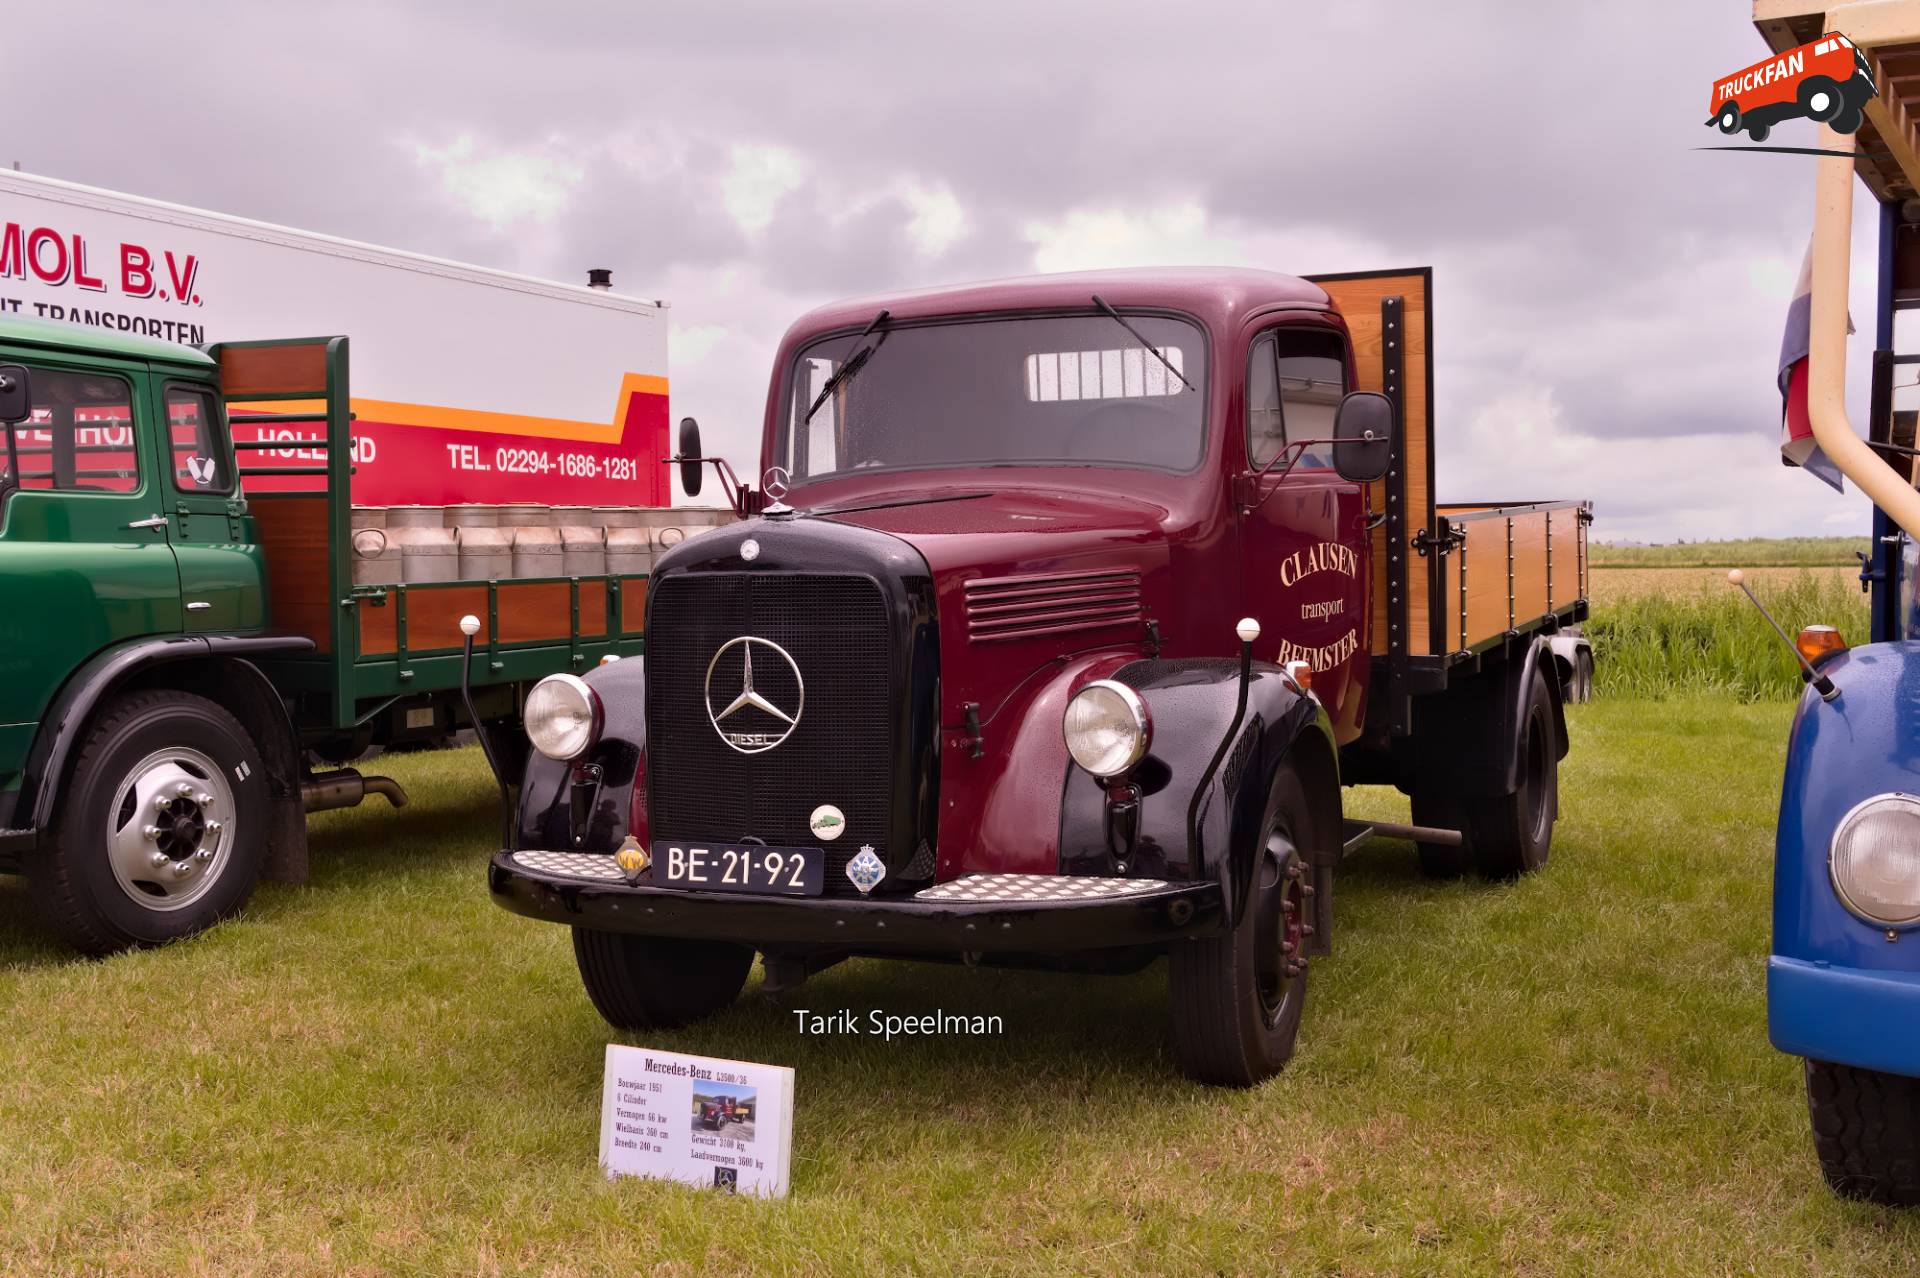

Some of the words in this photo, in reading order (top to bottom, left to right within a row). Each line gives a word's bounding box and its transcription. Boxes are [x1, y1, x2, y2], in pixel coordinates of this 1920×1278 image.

[120, 243, 203, 306] B.V.
[447, 444, 491, 471] TEL.
[496, 448, 637, 480] 02294-1686-1281
[1280, 542, 1359, 587] CLAUSEN
[1301, 598, 1344, 622] transport
[731, 733, 773, 746] DIESEL
[667, 847, 806, 887] BE-21-92
[644, 1058, 712, 1080] Mercedes-Benz
[616, 1107, 645, 1121] Vermogen
[614, 1137, 637, 1149] Breedte
[639, 1141, 651, 1152] 240
[691, 1133, 717, 1146] Gewicht
[690, 1149, 736, 1165] Laadvermogen
